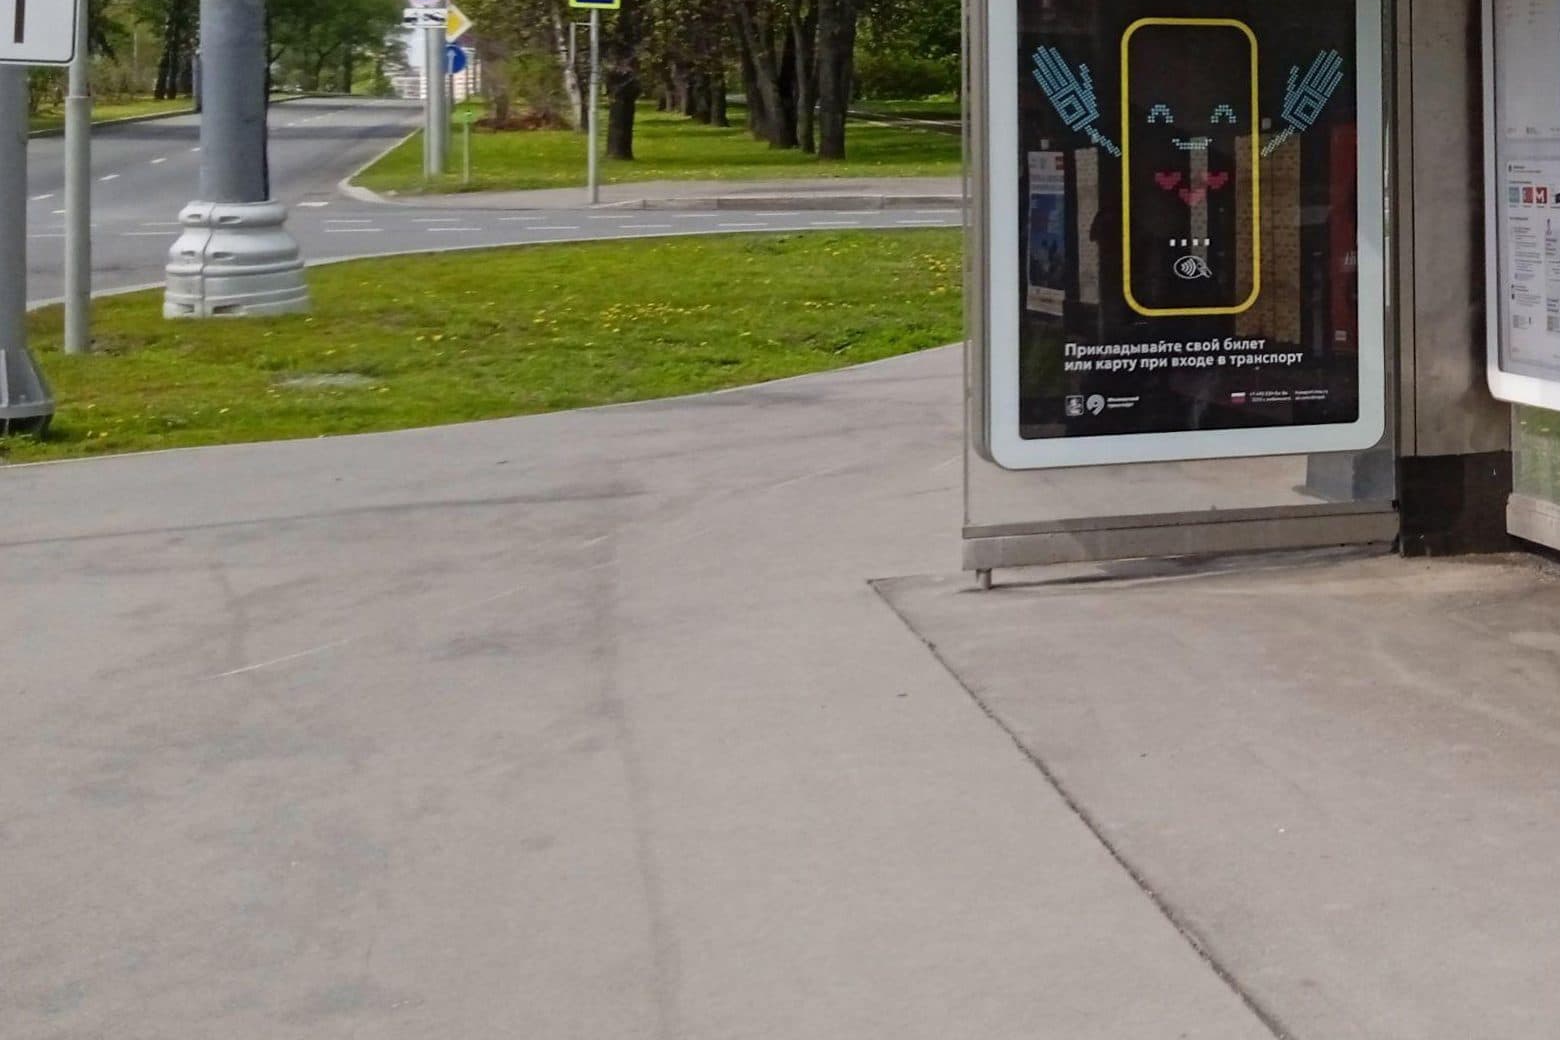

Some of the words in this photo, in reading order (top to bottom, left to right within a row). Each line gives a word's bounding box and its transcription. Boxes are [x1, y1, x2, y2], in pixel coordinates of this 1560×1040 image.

[1064, 340, 1182, 358] Прикладывайте
[1186, 339, 1220, 352] свой
[1223, 337, 1265, 351] билет
[1064, 360, 1092, 371] или
[1096, 359, 1137, 373] карту
[1140, 357, 1168, 370] при
[1172, 356, 1214, 368] входе
[1218, 355, 1226, 365] в
[1229, 351, 1303, 368] транспорт
